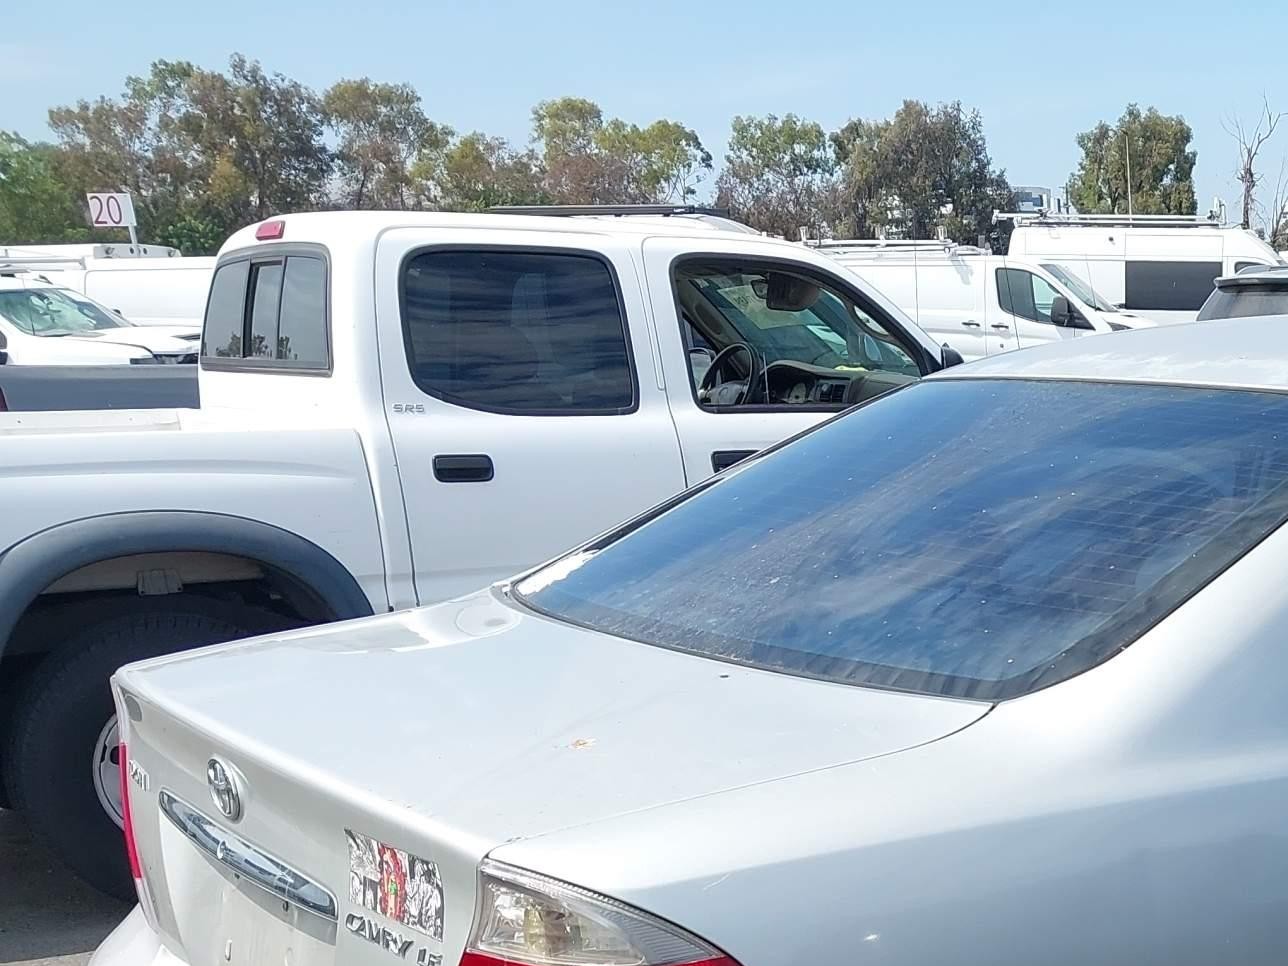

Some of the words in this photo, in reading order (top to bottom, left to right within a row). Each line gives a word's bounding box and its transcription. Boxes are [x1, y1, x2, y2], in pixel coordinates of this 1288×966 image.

[89, 195, 123, 225] 20
[393, 403, 425, 413] SR5
[345, 913, 414, 957] CAMRY
